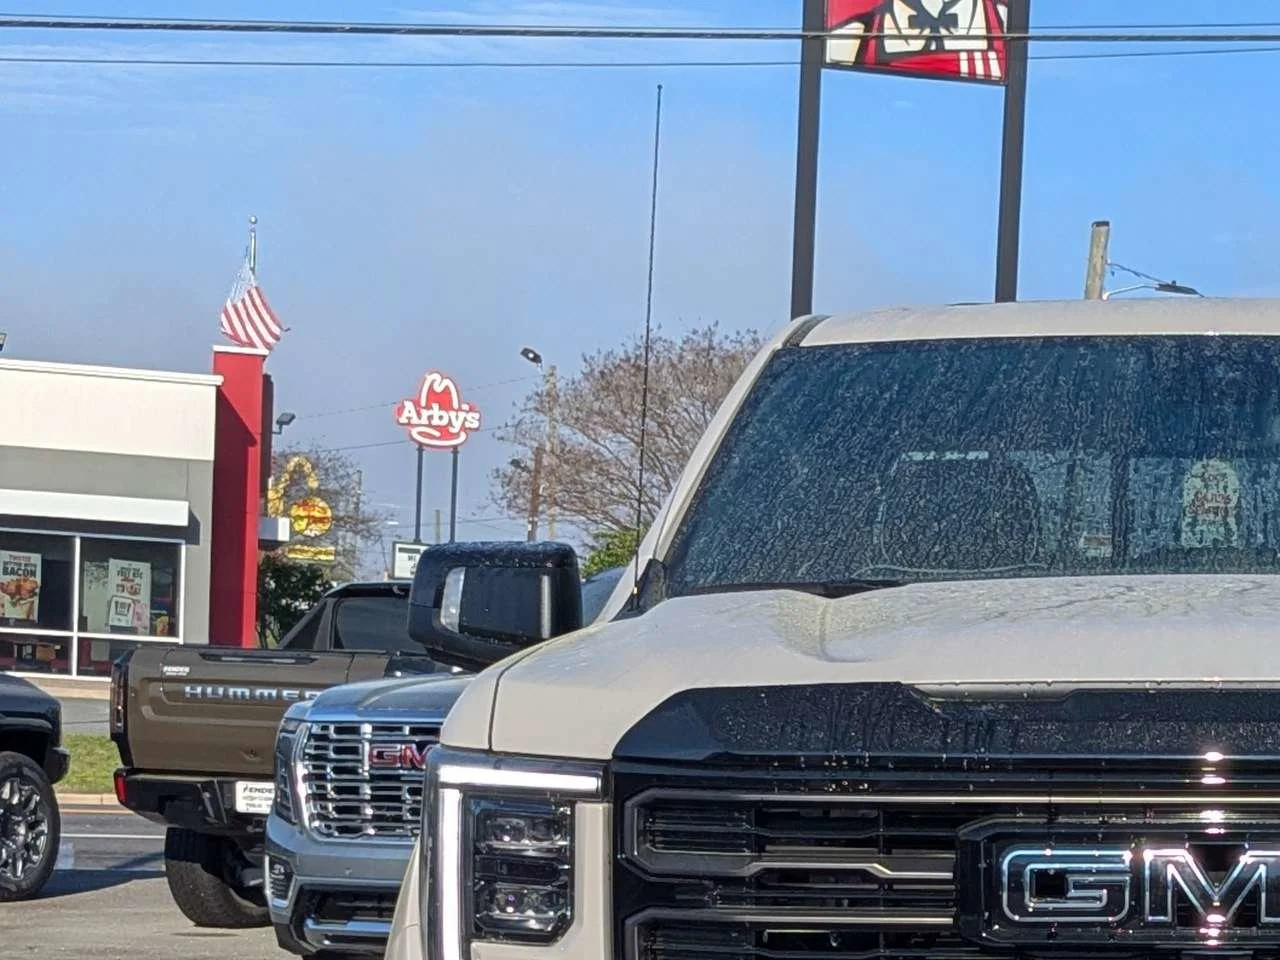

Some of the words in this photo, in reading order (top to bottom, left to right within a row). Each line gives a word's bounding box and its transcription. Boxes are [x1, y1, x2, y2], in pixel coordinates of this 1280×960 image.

[398, 400, 480, 433] Arby's
[2, 566, 37, 578] BACON
[368, 743, 434, 769] GM
